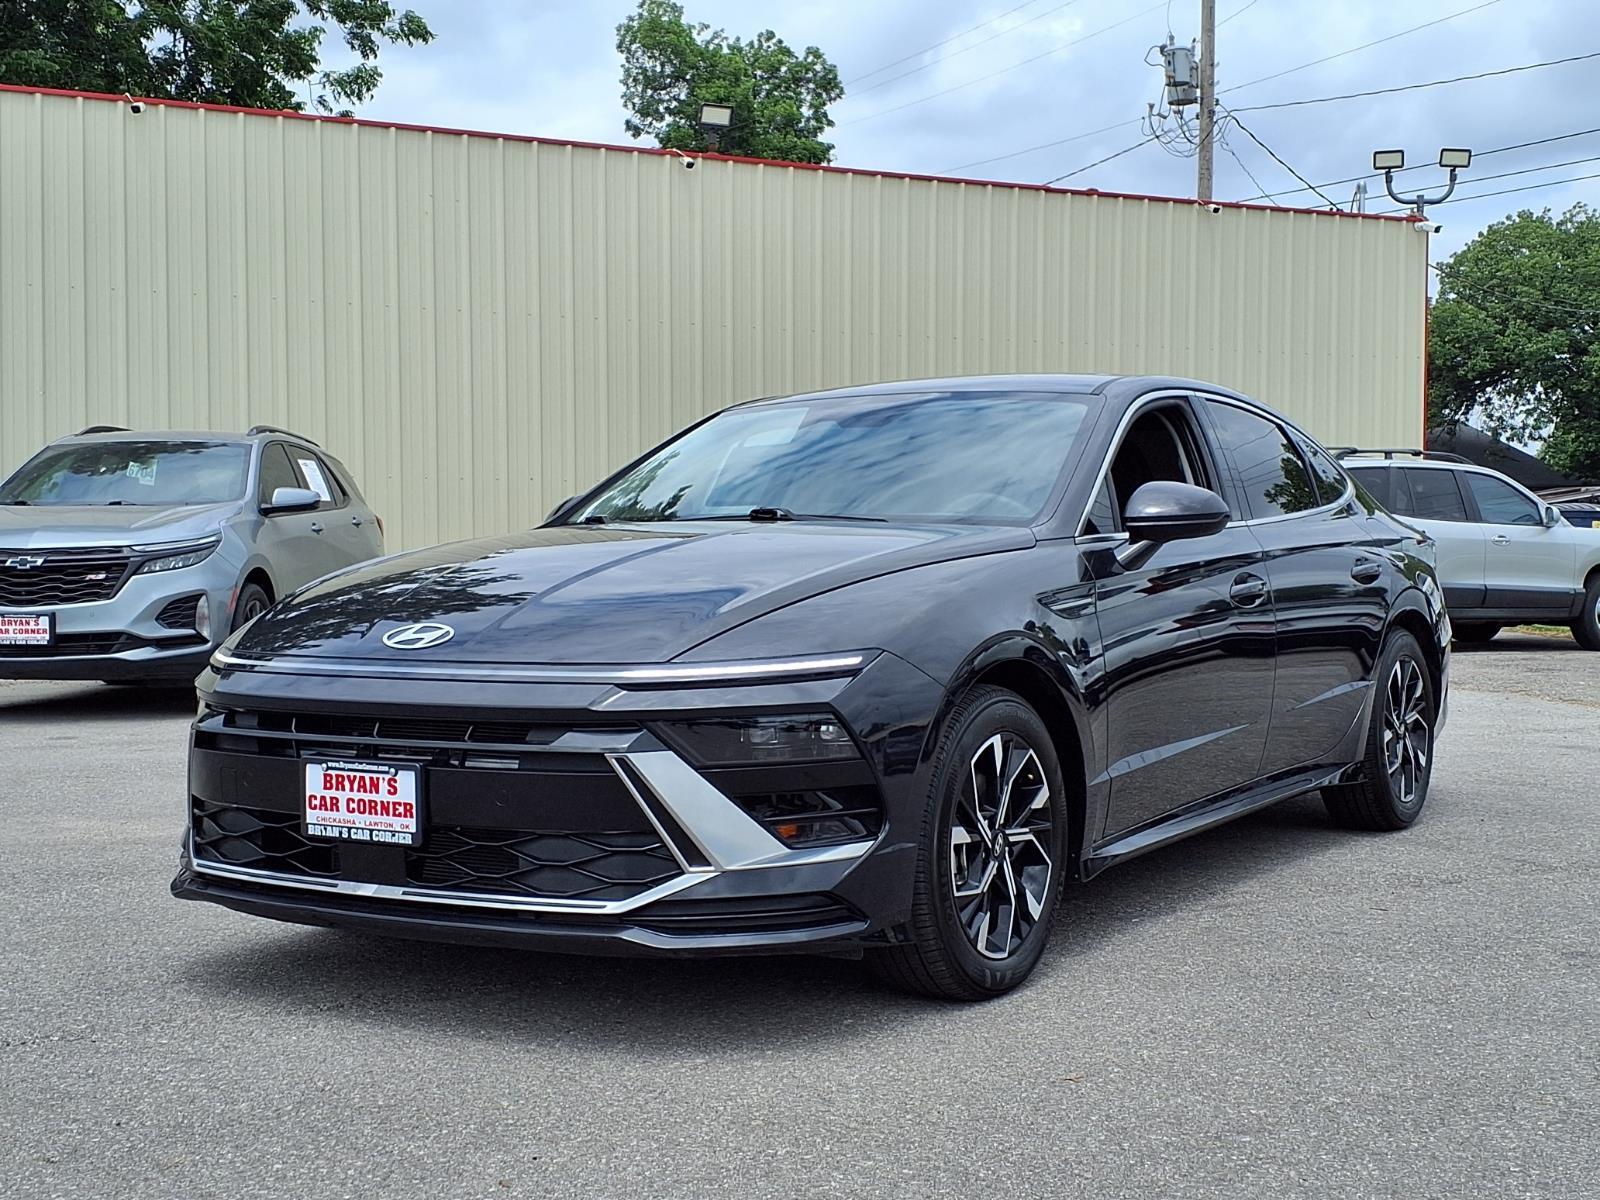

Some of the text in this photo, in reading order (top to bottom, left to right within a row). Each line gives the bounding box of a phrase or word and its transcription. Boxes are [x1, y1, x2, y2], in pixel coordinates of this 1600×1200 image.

[0, 619, 40, 627] BRYAN'S
[323, 773, 398, 796] BRYAN'S
[308, 794, 414, 819] CAR CORNER
[307, 823, 349, 838] BRYAN'S
[350, 828, 371, 840] CAR
[315, 815, 411, 831] CHICKASHA LAWTON, OK
